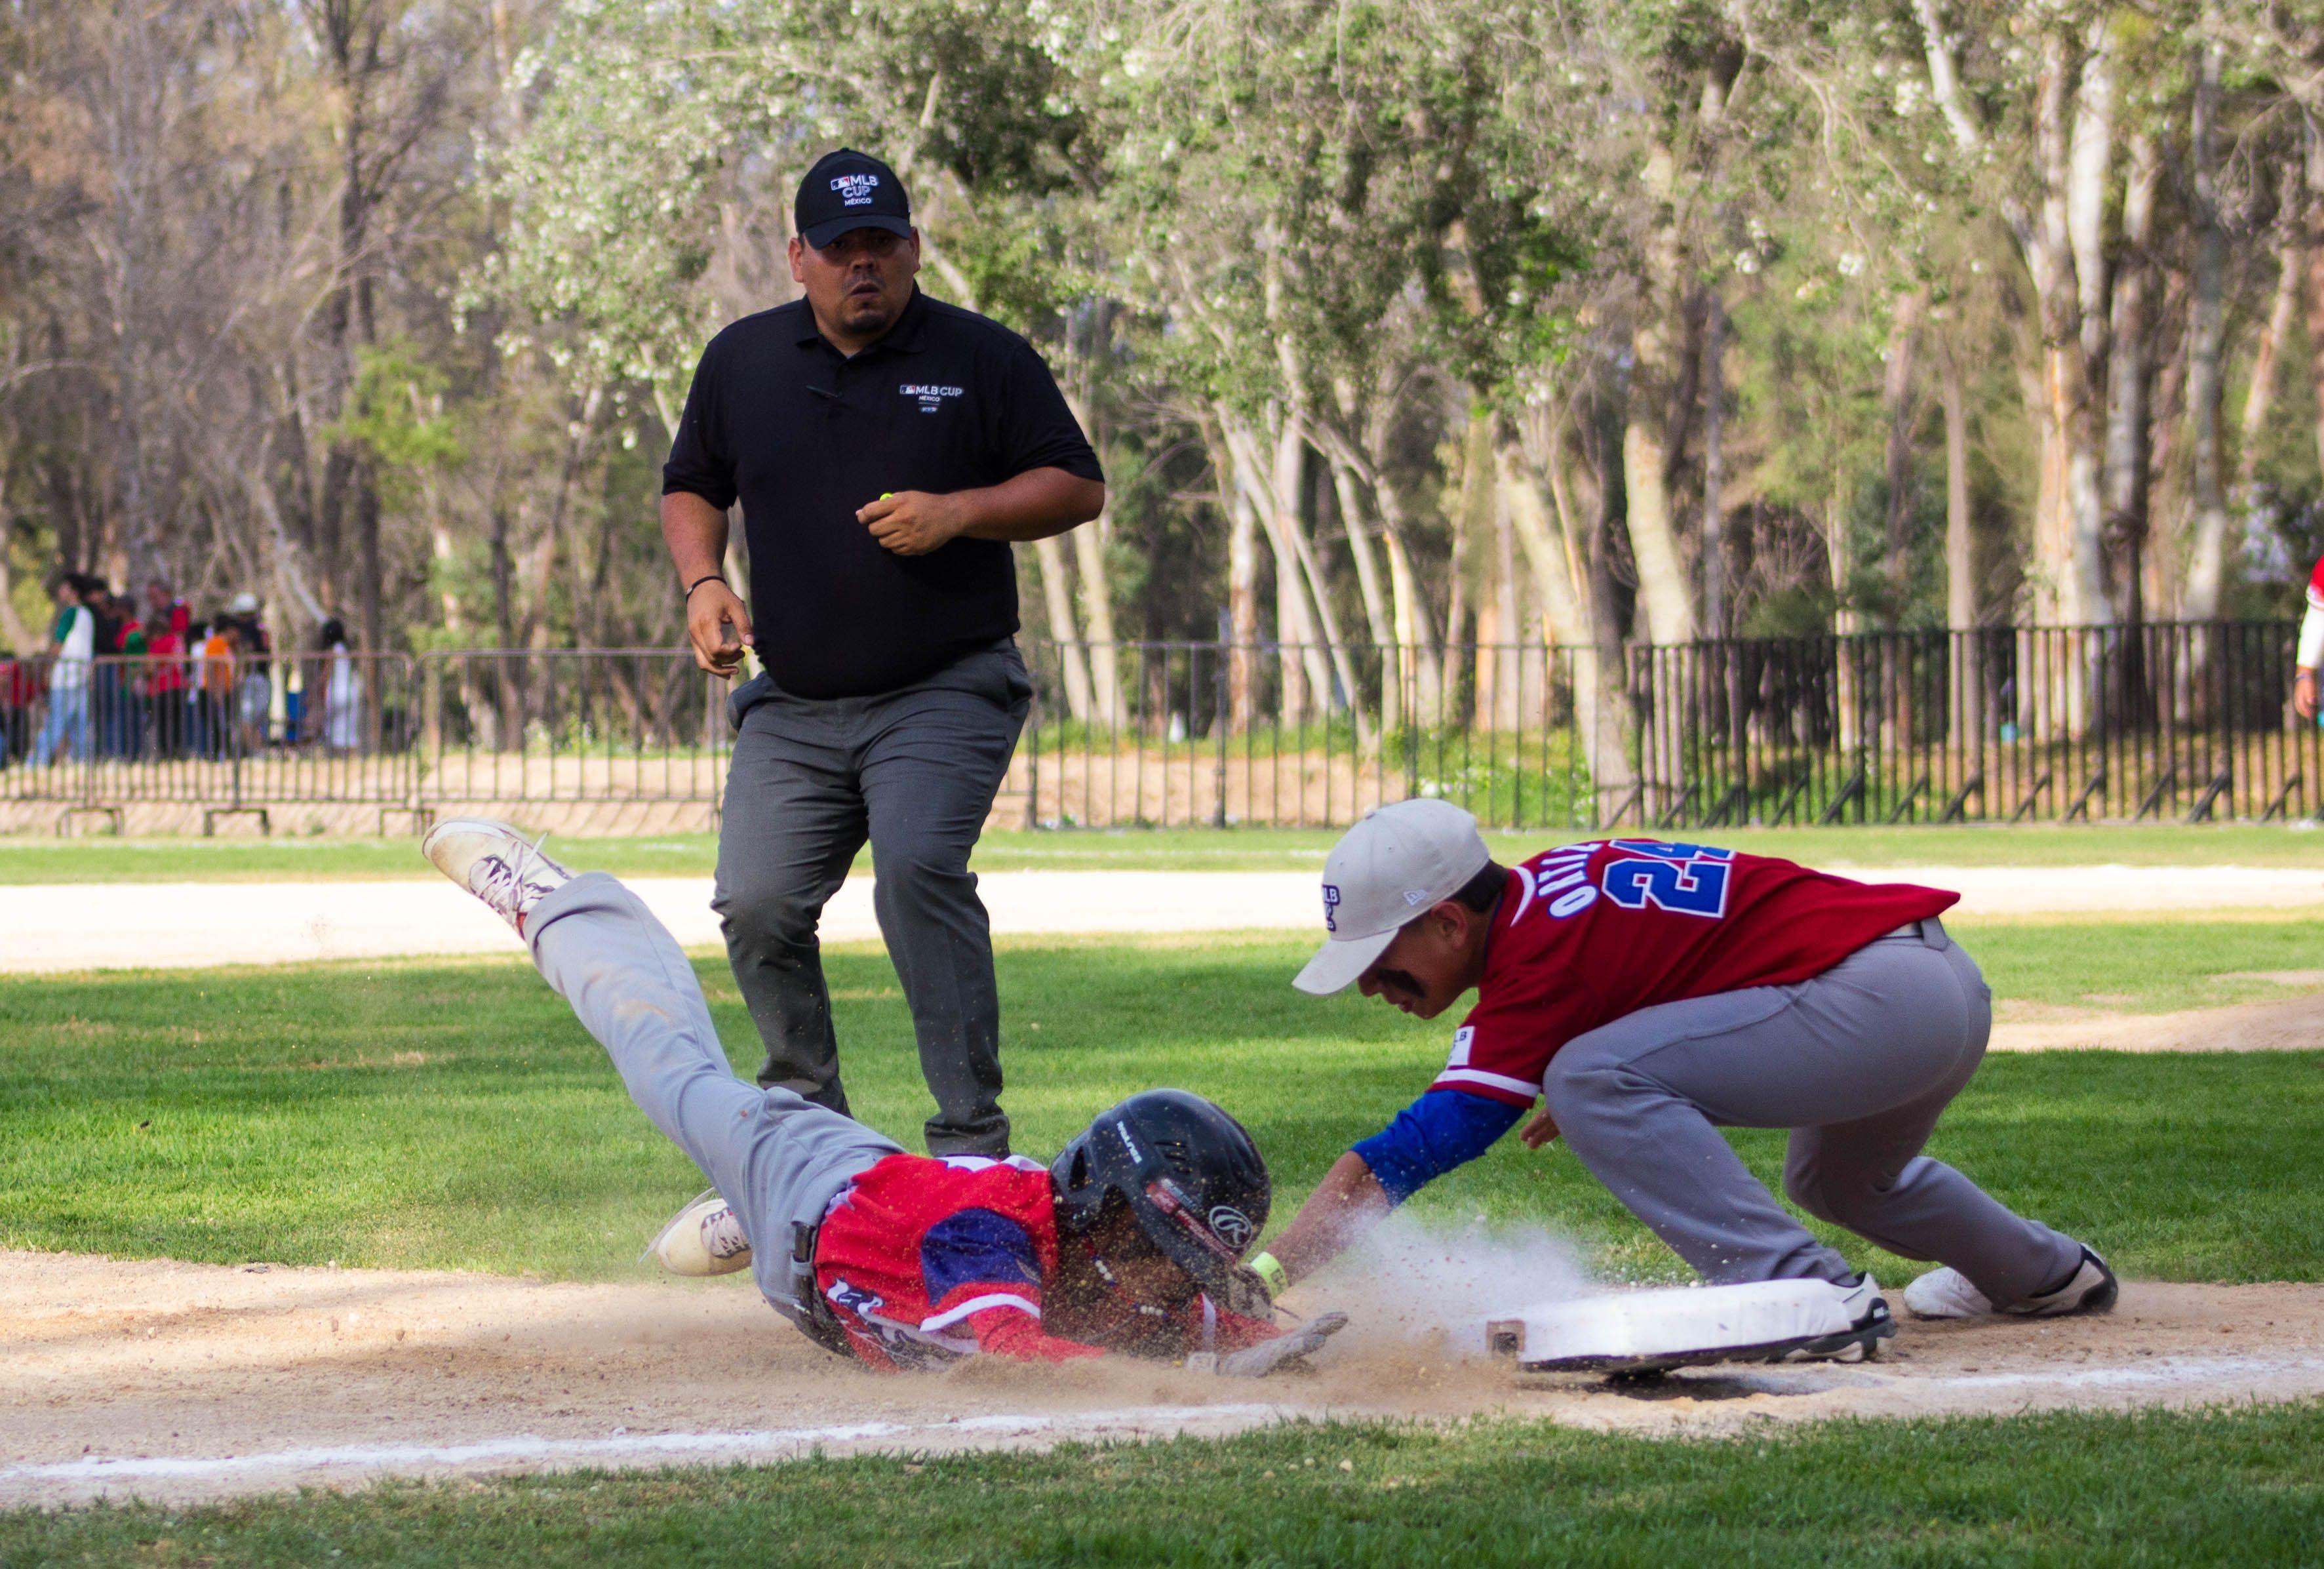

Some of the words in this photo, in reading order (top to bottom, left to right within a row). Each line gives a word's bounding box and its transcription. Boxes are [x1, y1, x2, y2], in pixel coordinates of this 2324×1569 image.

[850, 175, 878, 186] MLB
[842, 186, 871, 198] CUP
[916, 386, 938, 395] MLB
[939, 387, 962, 397] CUP
